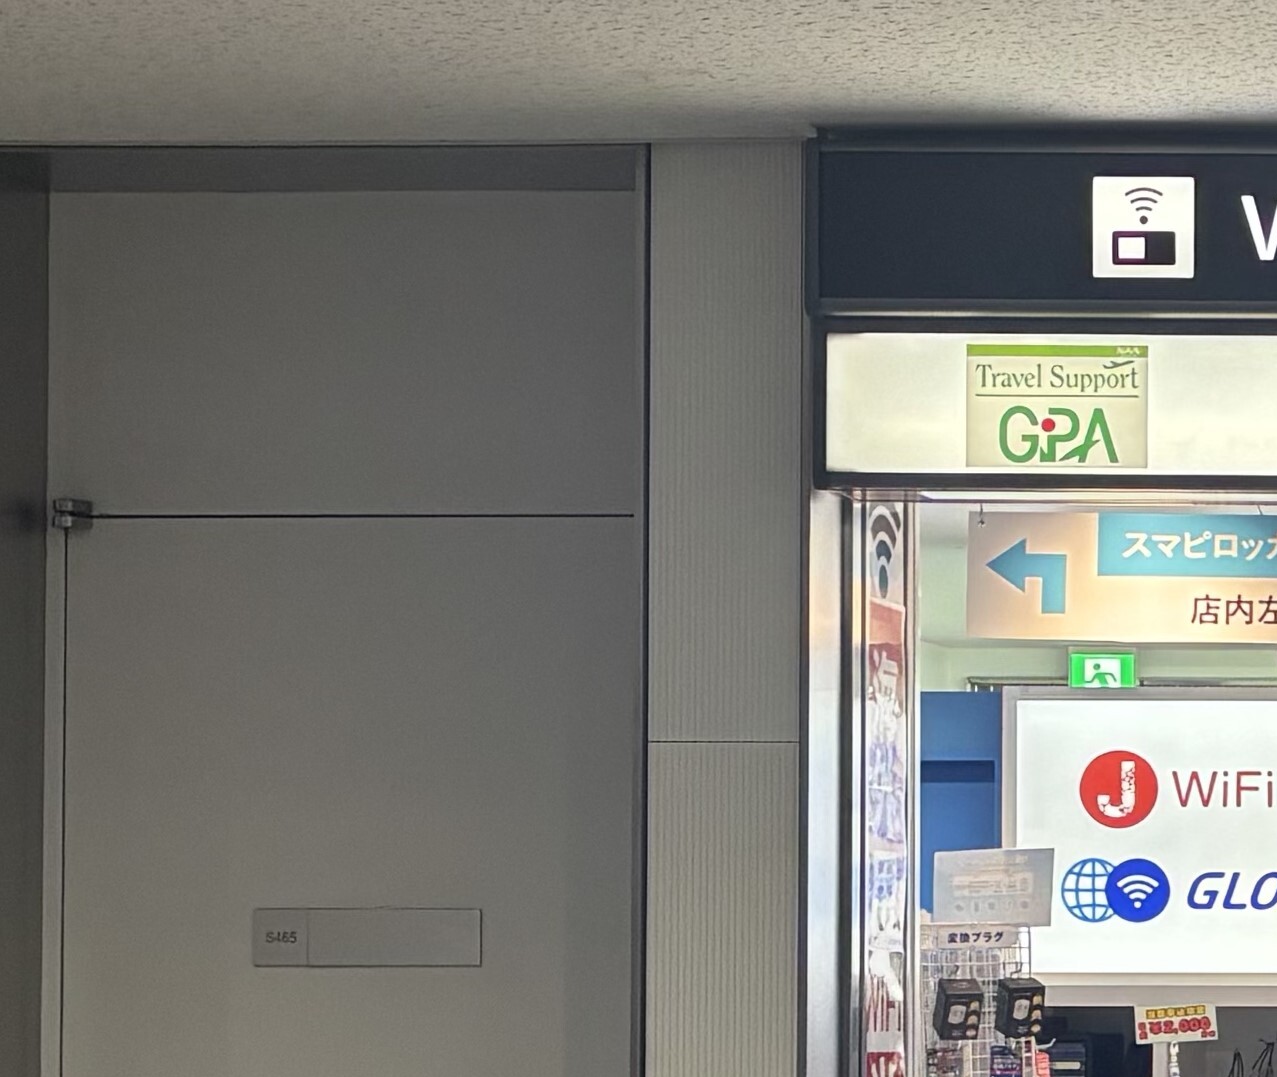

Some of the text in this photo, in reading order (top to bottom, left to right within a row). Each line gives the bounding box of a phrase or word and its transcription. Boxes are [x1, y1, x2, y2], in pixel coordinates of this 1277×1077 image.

[975, 363, 1139, 393] Travel Support
[999, 405, 1119, 463] GPA
[1172, 769, 1274, 809] WiFi
